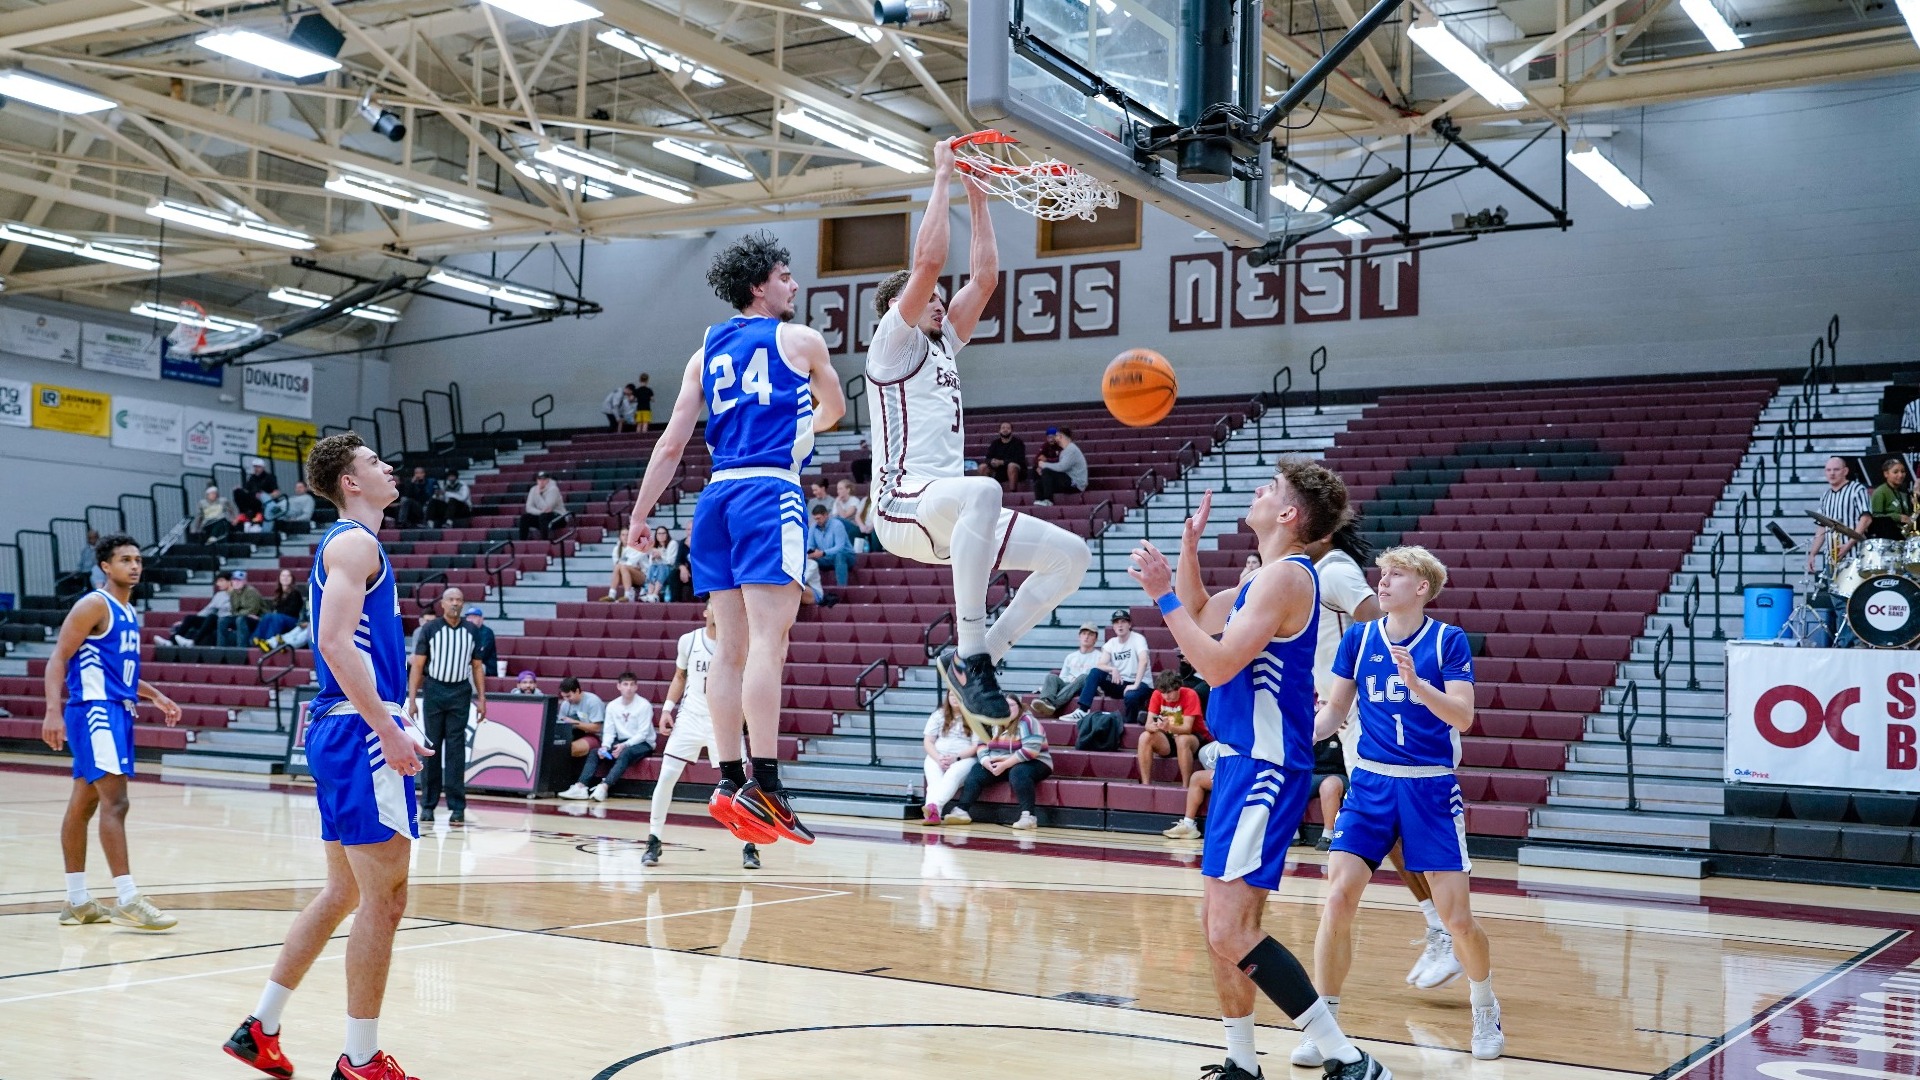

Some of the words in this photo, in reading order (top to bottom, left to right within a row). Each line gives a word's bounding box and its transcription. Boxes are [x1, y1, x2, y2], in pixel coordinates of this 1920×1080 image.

[809, 267, 1114, 349] EES
[1173, 242, 1413, 325] NEST
[245, 367, 302, 392] DONATOS
[709, 347, 773, 416] 24
[951, 395, 960, 434] 3
[1868, 604, 1886, 616] OC
[123, 659, 136, 688] 10
[1114, 651, 1131, 661] VANS
[1886, 672, 1920, 720] S
[1391, 713, 1405, 746] 1
[1753, 684, 1861, 752] OC
[1886, 723, 1920, 770] B
